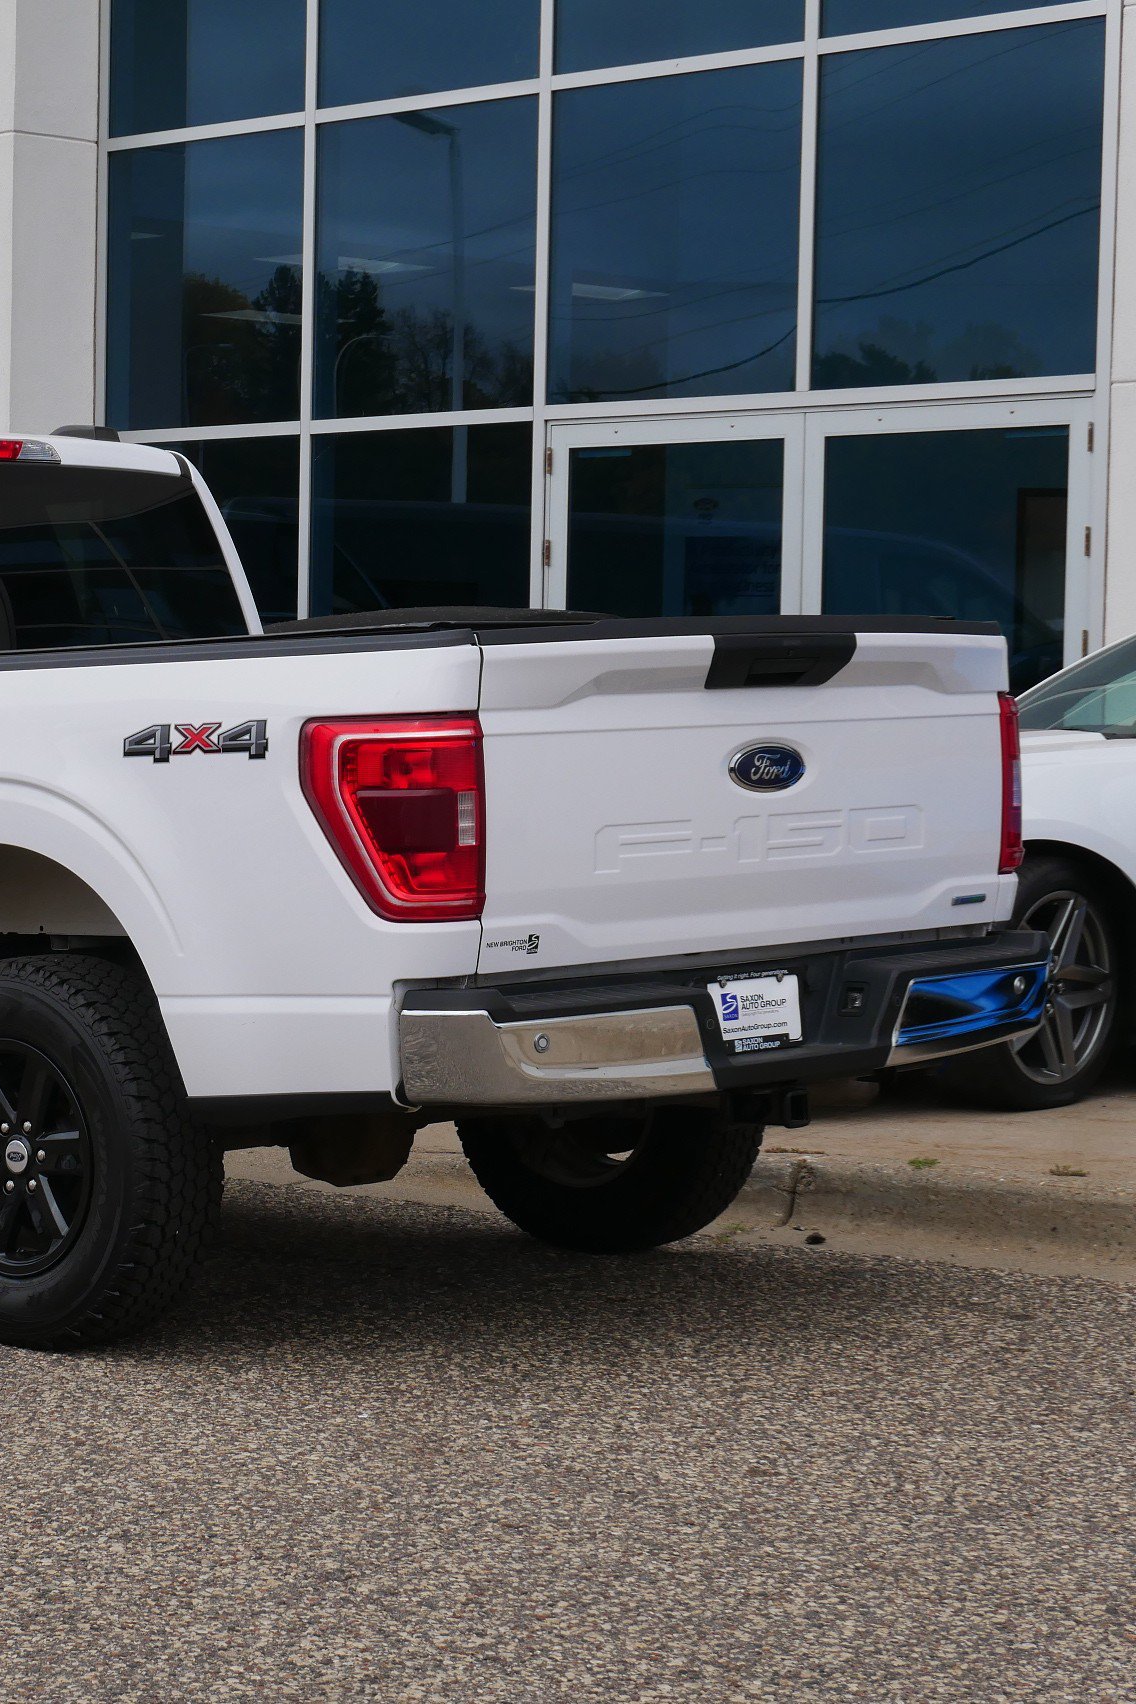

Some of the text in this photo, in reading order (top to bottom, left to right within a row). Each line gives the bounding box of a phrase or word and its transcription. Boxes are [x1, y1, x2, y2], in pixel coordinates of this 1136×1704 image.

[750, 753, 792, 781] Ford
[593, 804, 925, 875] F-150
[500, 939, 528, 947] BRIGHTON
[740, 994, 764, 1003] SAXON
[741, 998, 787, 1010] AUTO GROUP
[722, 1021, 788, 1034] SaxonAutoGroup.com
[743, 1043, 759, 1051] AUTO
[760, 1041, 781, 1049] GROUP
